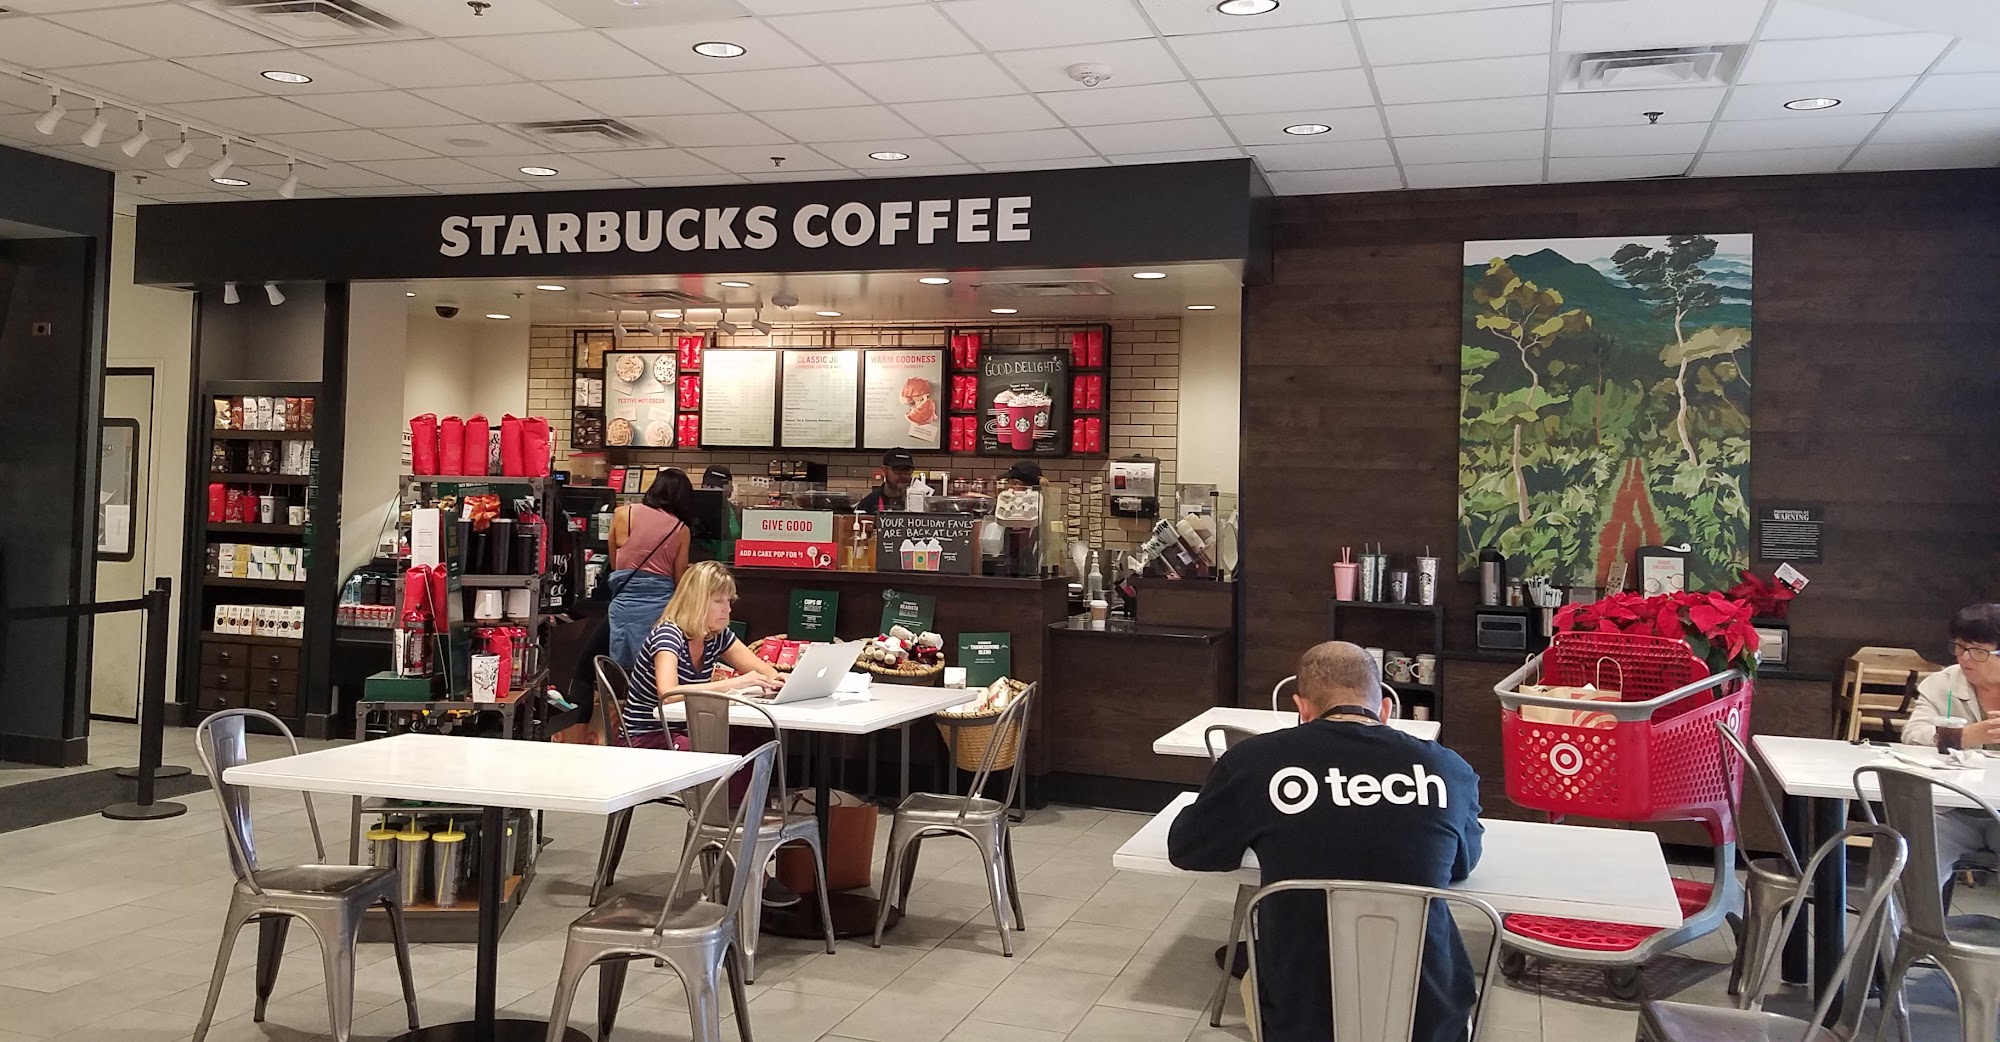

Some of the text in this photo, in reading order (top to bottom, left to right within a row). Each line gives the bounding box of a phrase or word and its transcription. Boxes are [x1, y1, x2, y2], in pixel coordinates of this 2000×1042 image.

[440, 196, 1031, 257] STARBUCKS COFFEE
[797, 355, 828, 364] CLASSIC
[870, 355, 936, 364] WARM GOODNESS
[985, 361, 1061, 377] GOOD DELIGHTS
[762, 519, 813, 532] GIVE GOOD
[880, 517, 974, 529] YOUR HOLIDAY FAVES
[883, 528, 971, 538] ARE BACK AT LAST
[740, 549, 752, 557] ADD
[757, 550, 773, 558] CAKE
[786, 551, 798, 559] FOR
[1324, 764, 1447, 808] tech
